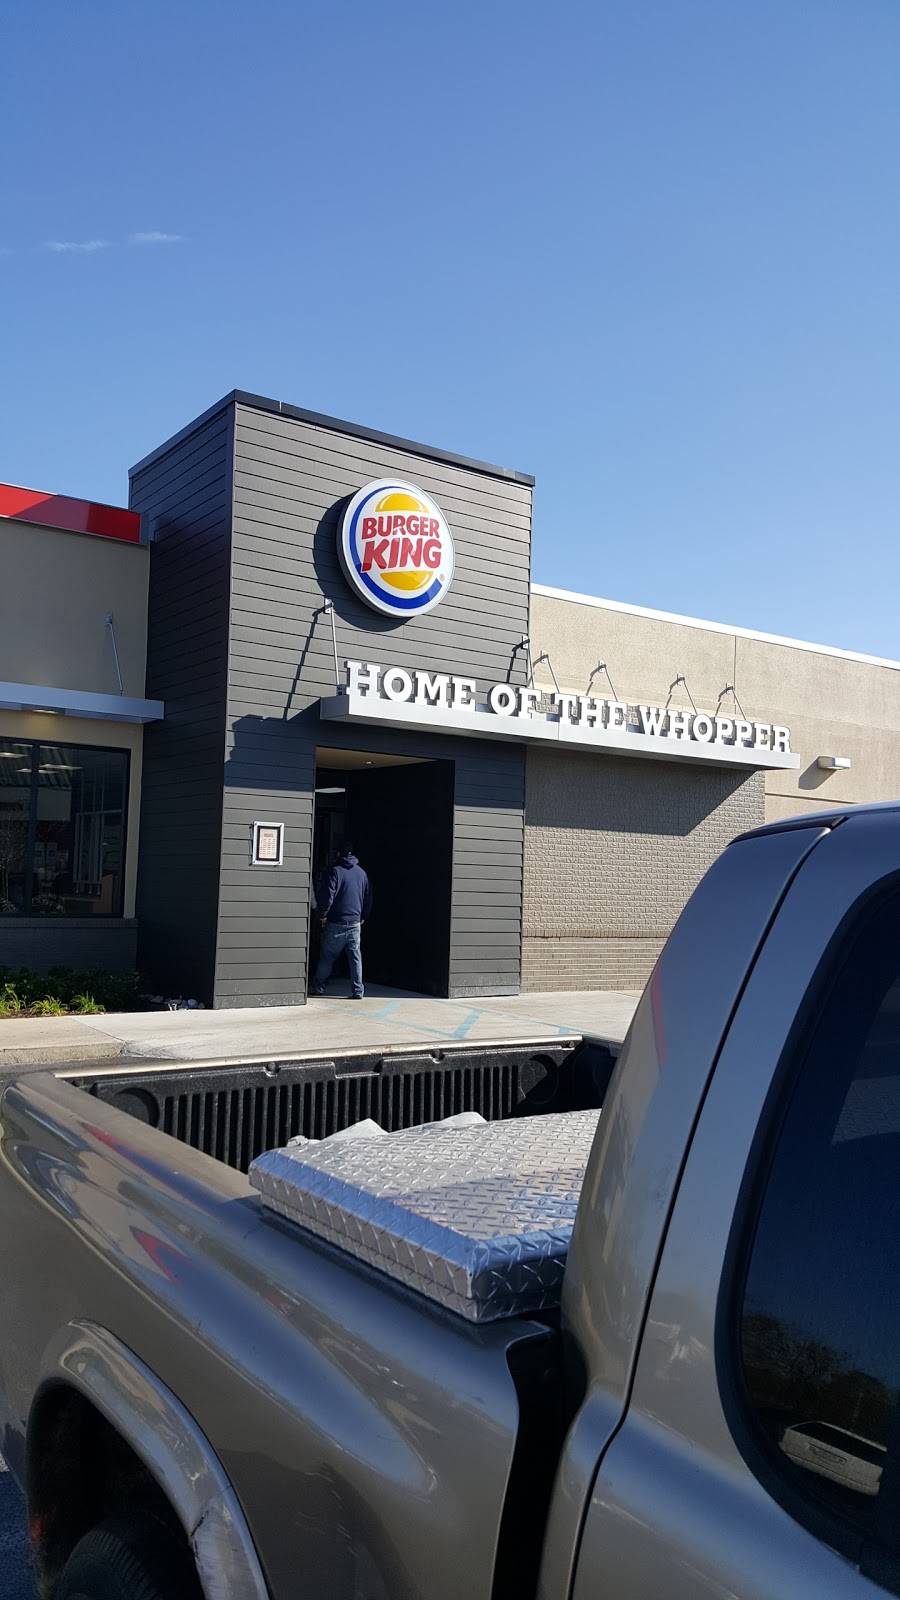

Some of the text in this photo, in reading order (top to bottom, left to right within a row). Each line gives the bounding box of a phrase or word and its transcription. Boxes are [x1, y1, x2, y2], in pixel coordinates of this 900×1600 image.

[361, 515, 440, 540] BURGER
[362, 537, 442, 572] KING
[346, 660, 791, 753] HOME OF THE WHOPPER
